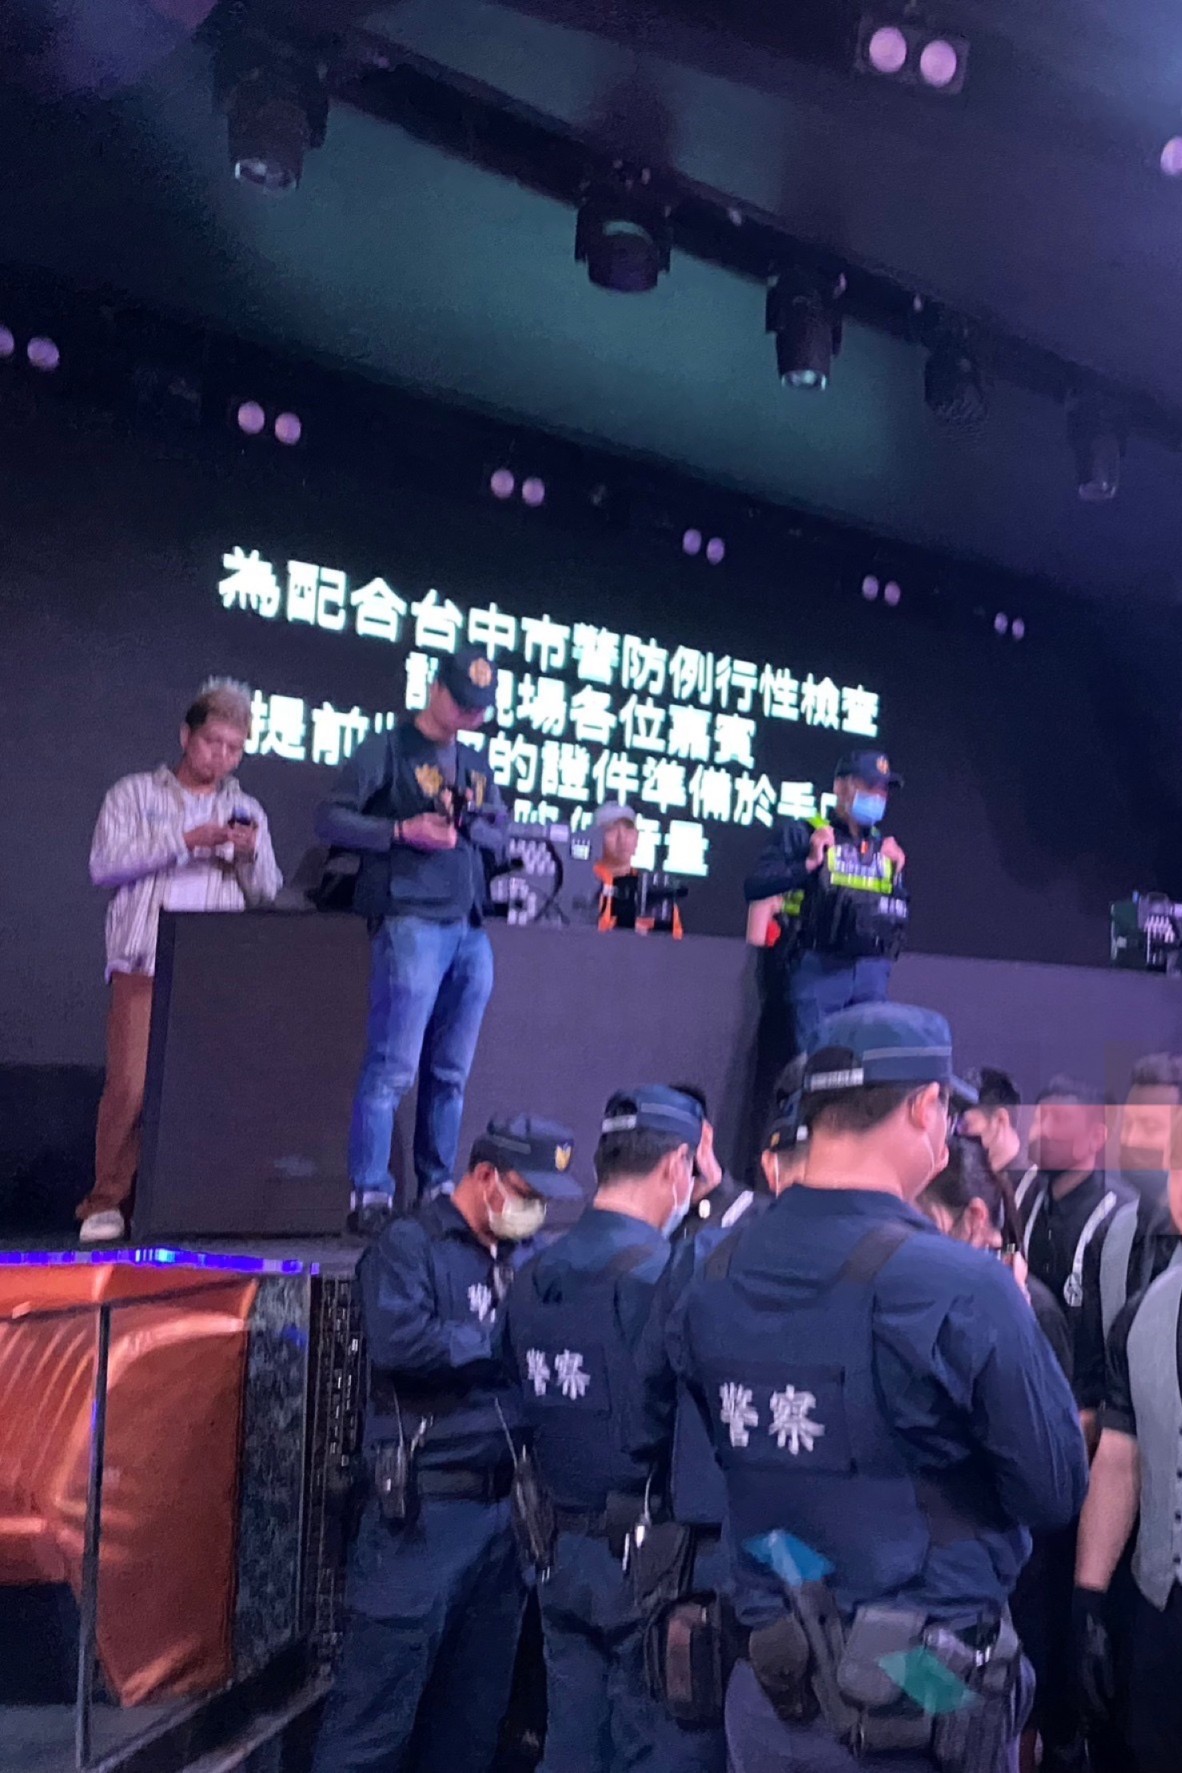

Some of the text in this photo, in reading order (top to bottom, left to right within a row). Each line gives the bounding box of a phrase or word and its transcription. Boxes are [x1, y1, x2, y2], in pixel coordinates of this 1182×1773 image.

[218, 546, 879, 738] 為配合台中市警防例行性檢查
[526, 1348, 591, 1400] 警察
[719, 1381, 825, 1455] 警察
